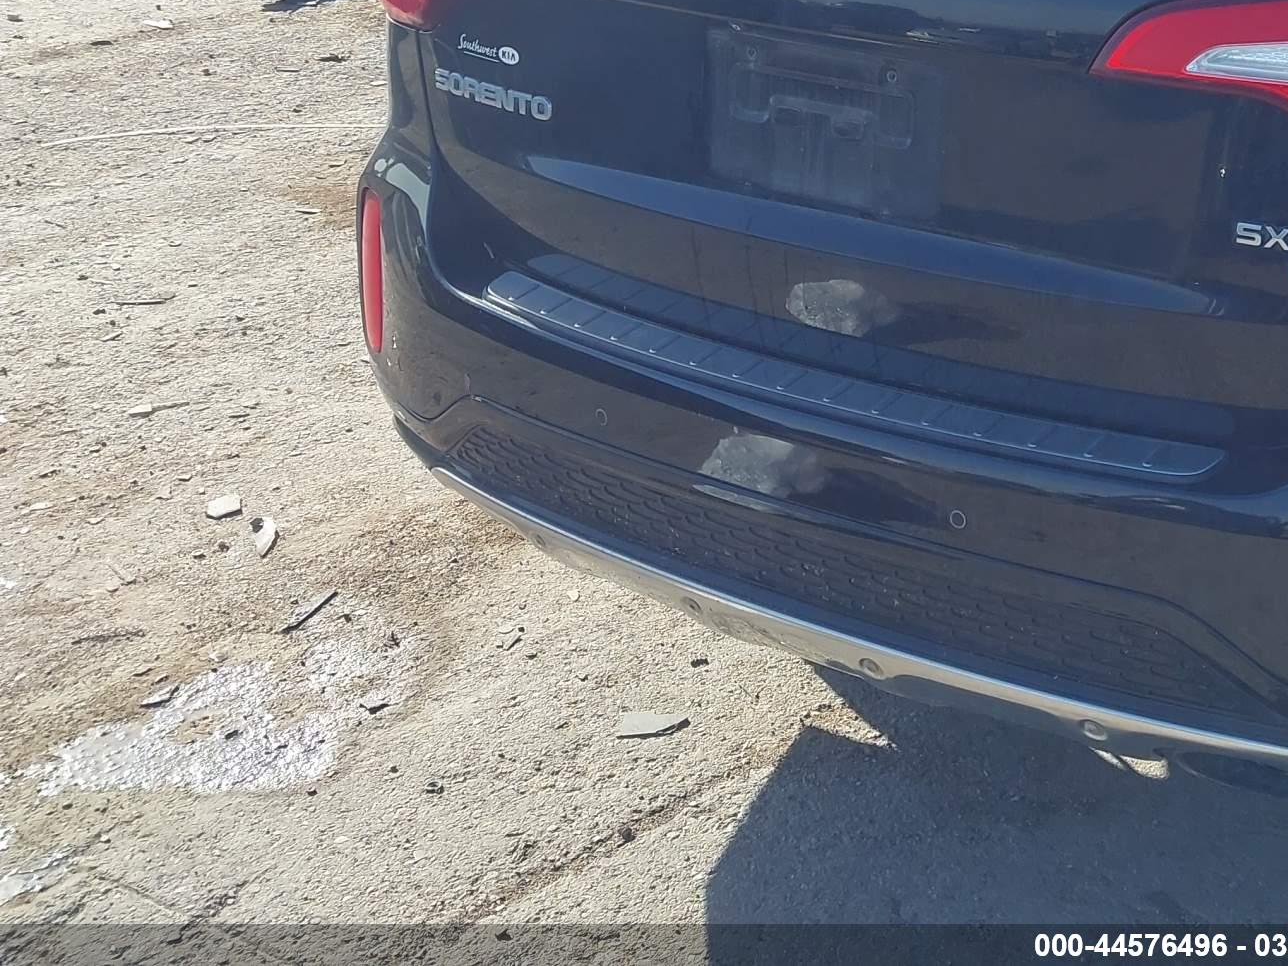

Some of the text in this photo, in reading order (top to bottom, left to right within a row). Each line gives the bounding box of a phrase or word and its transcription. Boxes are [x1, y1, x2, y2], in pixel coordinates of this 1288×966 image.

[457, 33, 518, 64] Southwest KIA
[434, 67, 552, 121] SORENTO
